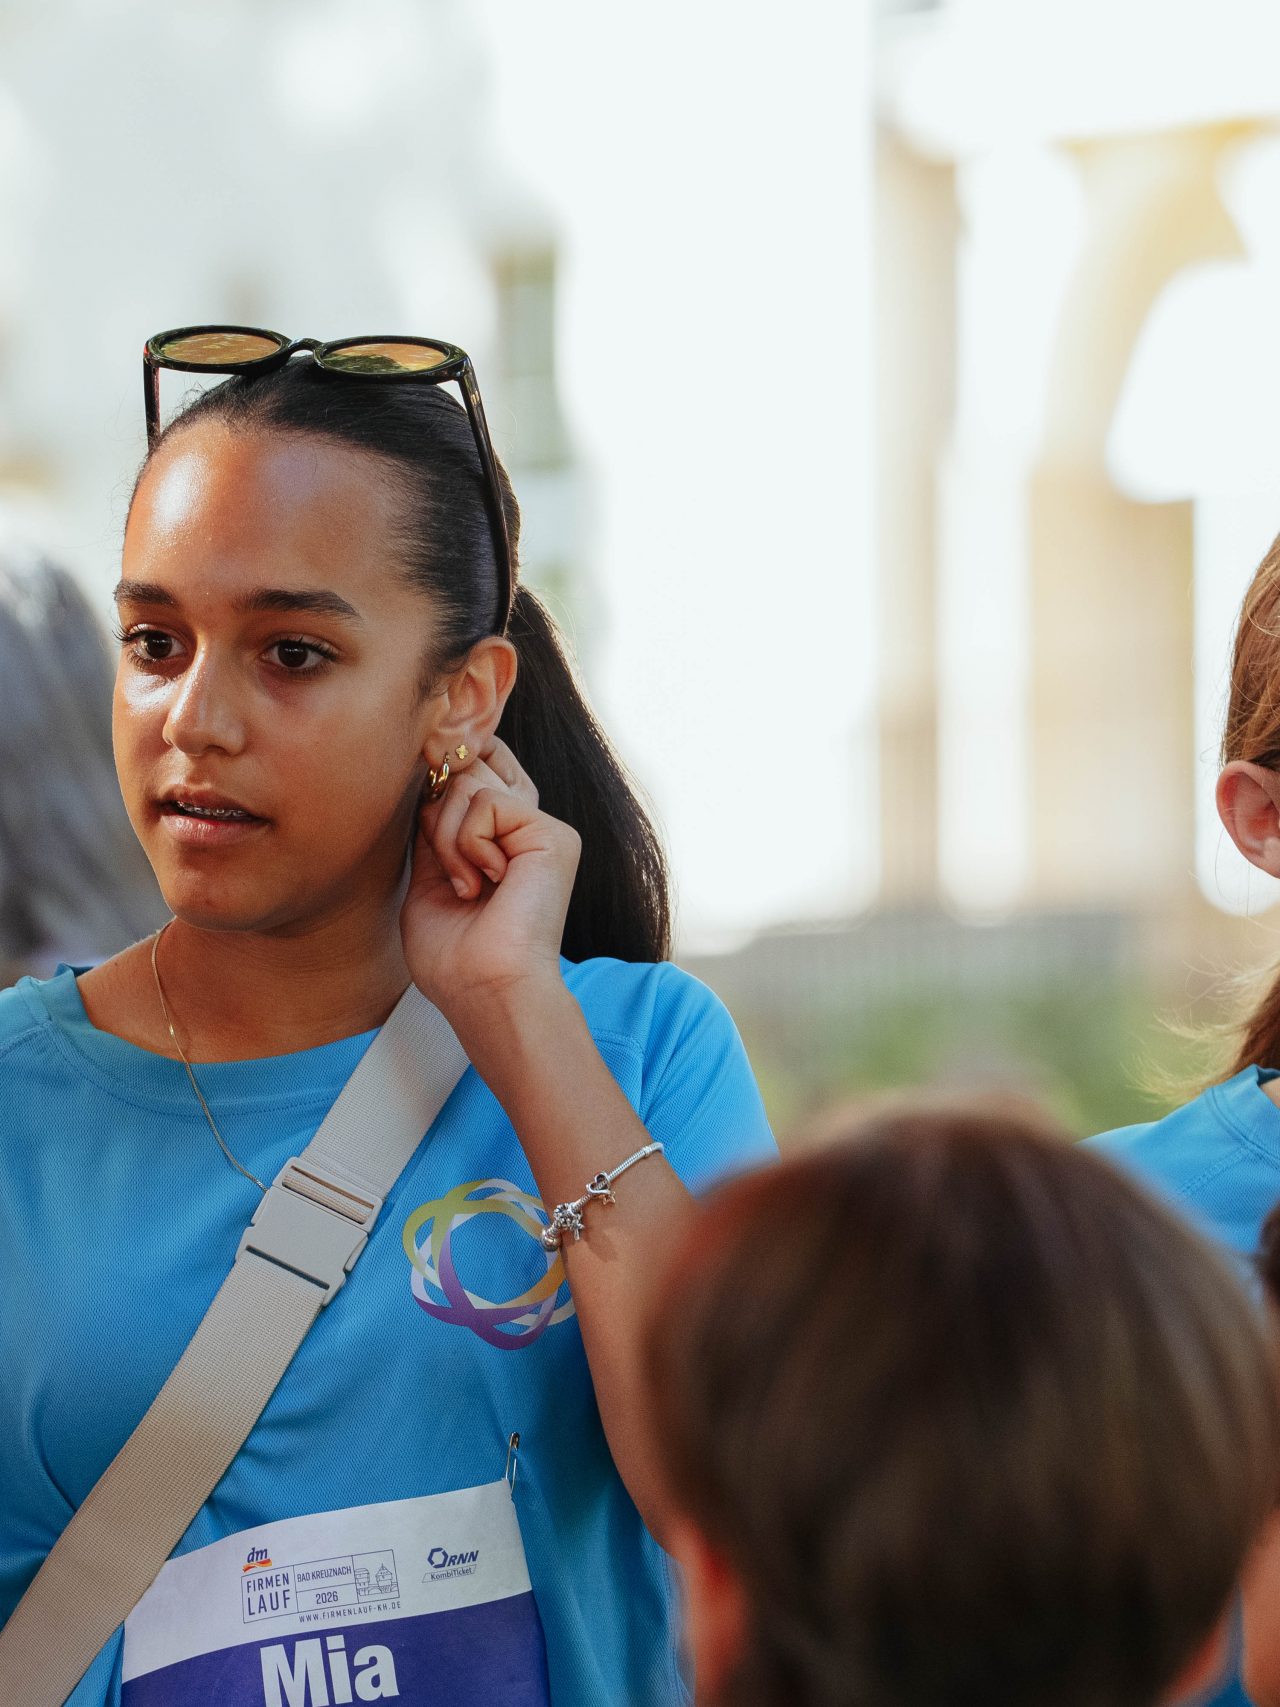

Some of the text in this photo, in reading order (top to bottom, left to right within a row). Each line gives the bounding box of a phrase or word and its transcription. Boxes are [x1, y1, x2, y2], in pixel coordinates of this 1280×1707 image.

[247, 1546, 268, 1564] dm
[447, 1550, 479, 1567] RNN
[246, 1572, 290, 1593] FIRMEN
[297, 1566, 352, 1583] BAD KREUZNACH
[430, 1567, 472, 1581] KombiTicket
[247, 1589, 291, 1616] LAUF
[315, 1591, 339, 1605] 2026
[299, 1601, 402, 1623] WWW.FIRMENLAUF-KH.DE
[260, 1634, 400, 1707] Mia
